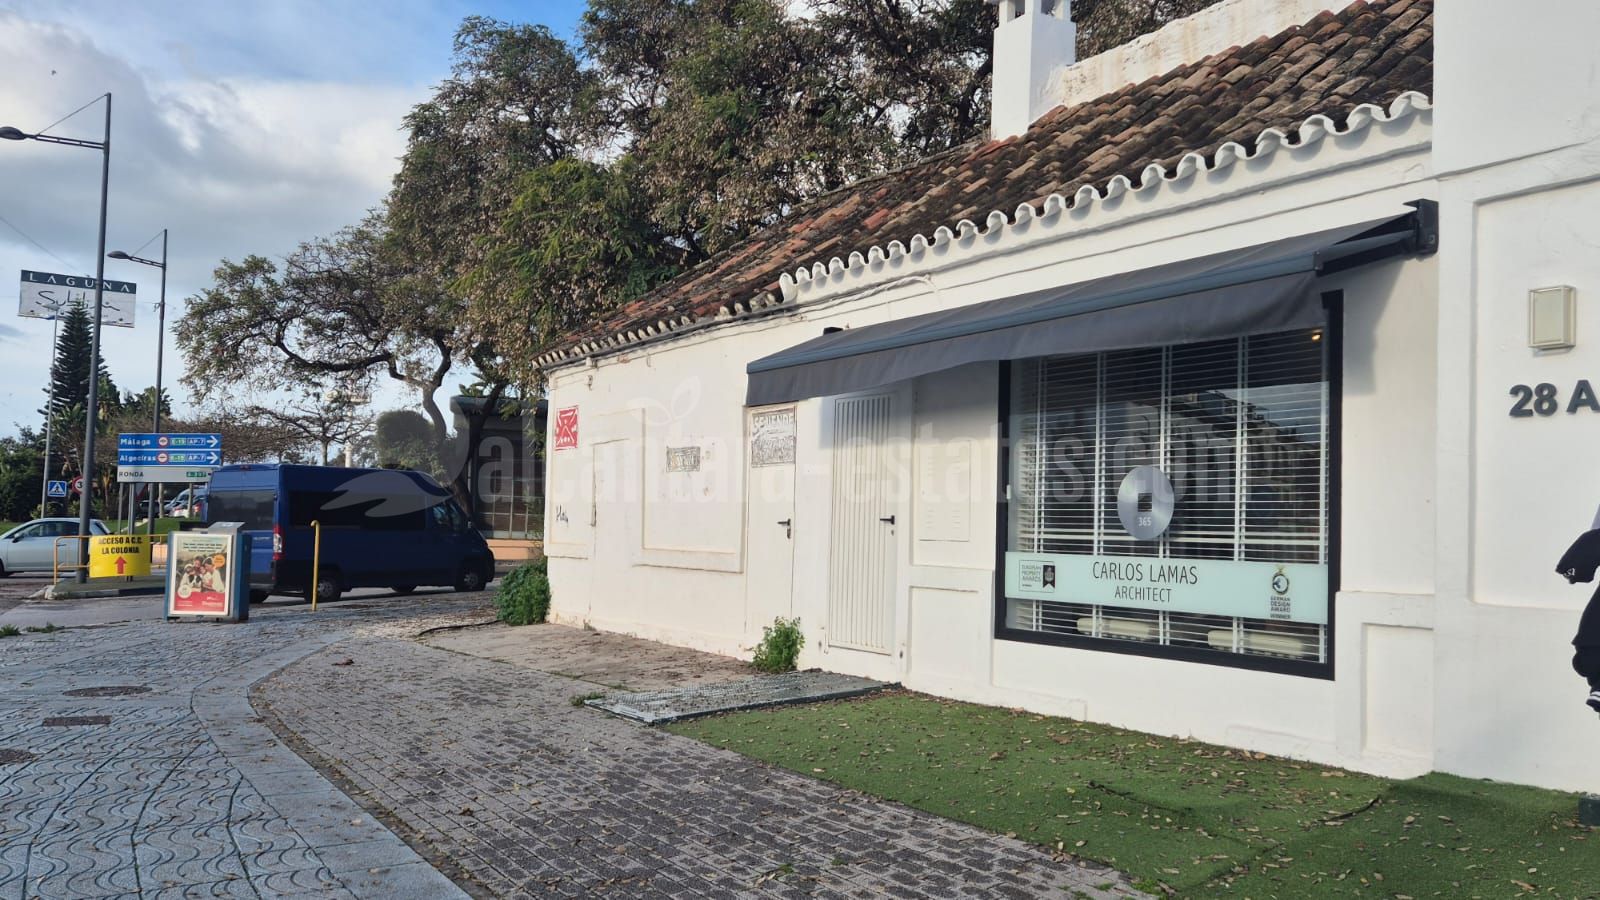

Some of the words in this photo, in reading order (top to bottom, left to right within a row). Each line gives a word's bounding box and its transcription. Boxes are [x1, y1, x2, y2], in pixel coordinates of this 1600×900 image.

[29, 272, 130, 293] LAGUNA
[1509, 382, 1558, 418] 28
[1566, 379, 1600, 414] A
[120, 438, 151, 447] Málaga
[120, 455, 156, 463] Algeciras
[1138, 516, 1151, 526] 365
[99, 536, 124, 544] ACCESO
[125, 536, 130, 544] A
[110, 546, 140, 554] COLONIA
[1092, 561, 1143, 582] CARLOS
[1149, 563, 1198, 585] LAMAS
[1114, 585, 1173, 603] ARCHITECT
